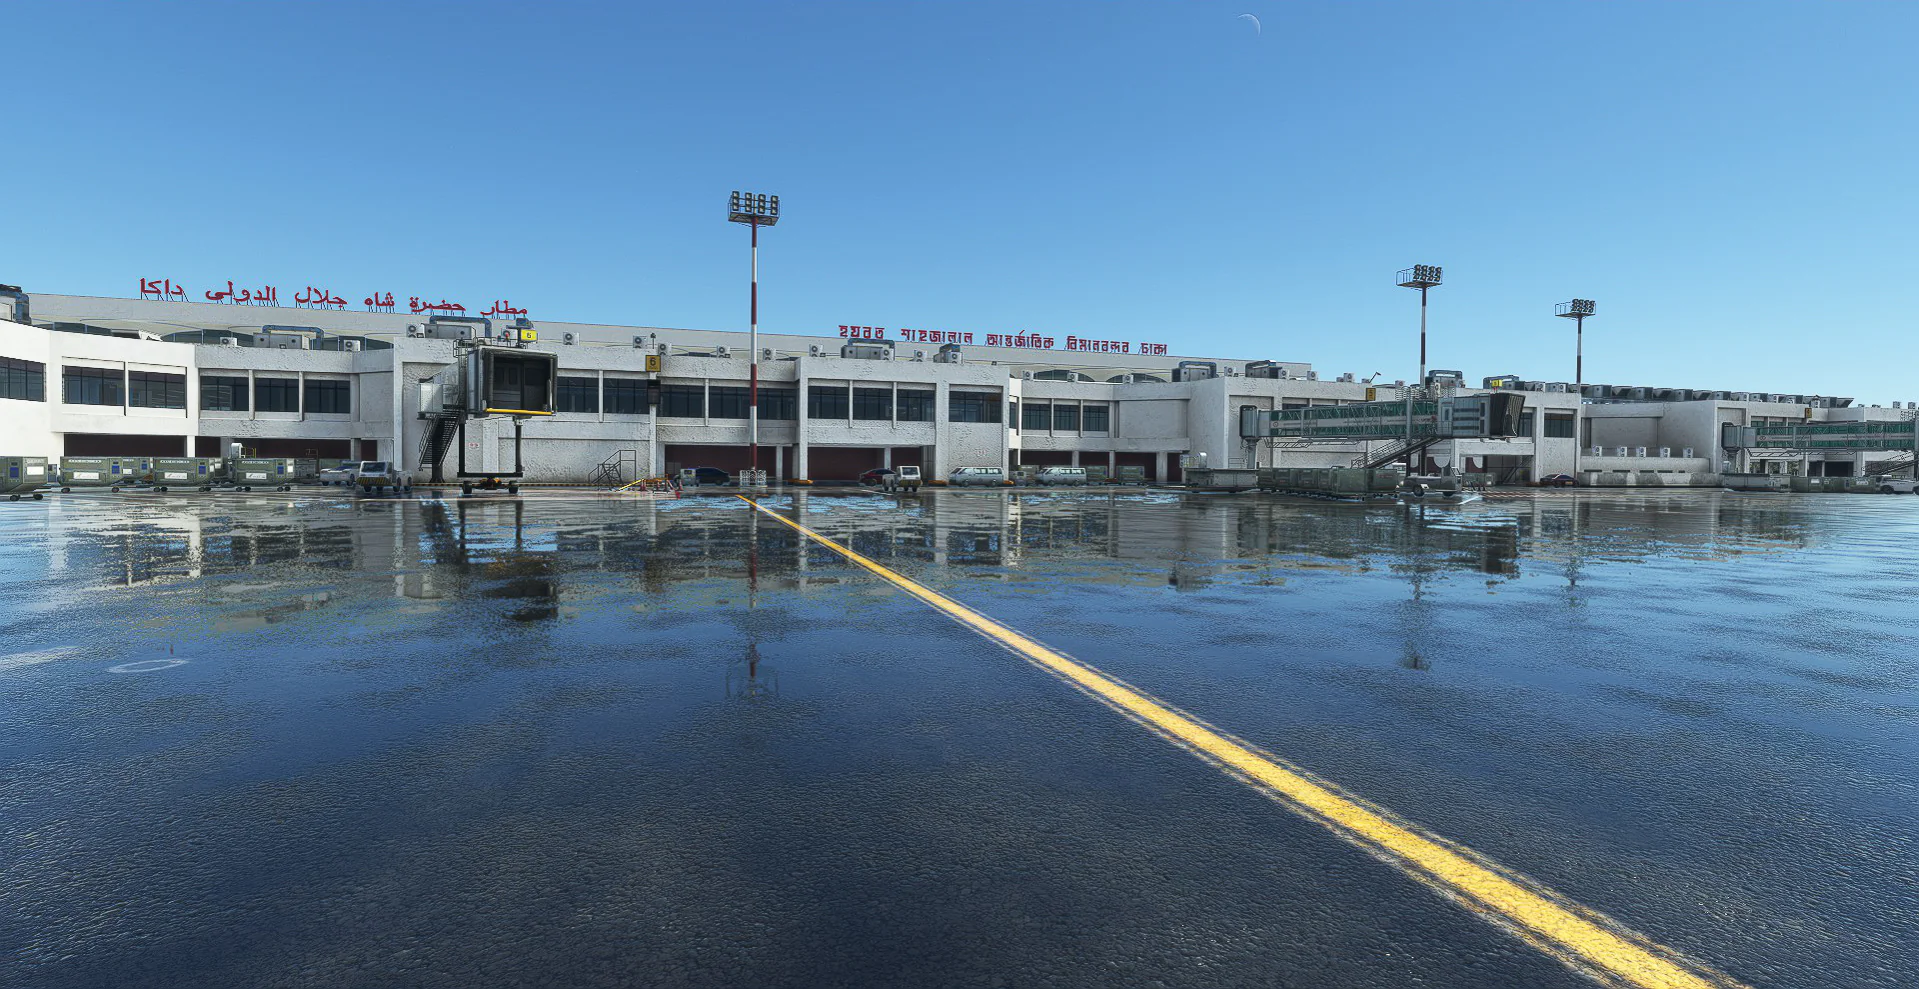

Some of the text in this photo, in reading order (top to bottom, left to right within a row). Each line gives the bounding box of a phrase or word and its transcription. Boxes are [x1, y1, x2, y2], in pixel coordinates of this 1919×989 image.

[139, 278, 184, 296] داكا
[294, 286, 348, 309] جلال
[364, 291, 395, 307] شاه
[409, 296, 466, 312] حضرة
[480, 300, 528, 316] مطار
[901, 328, 974, 344] শাহজালাল
[986, 329, 1054, 349] আন্তর্জাতিক
